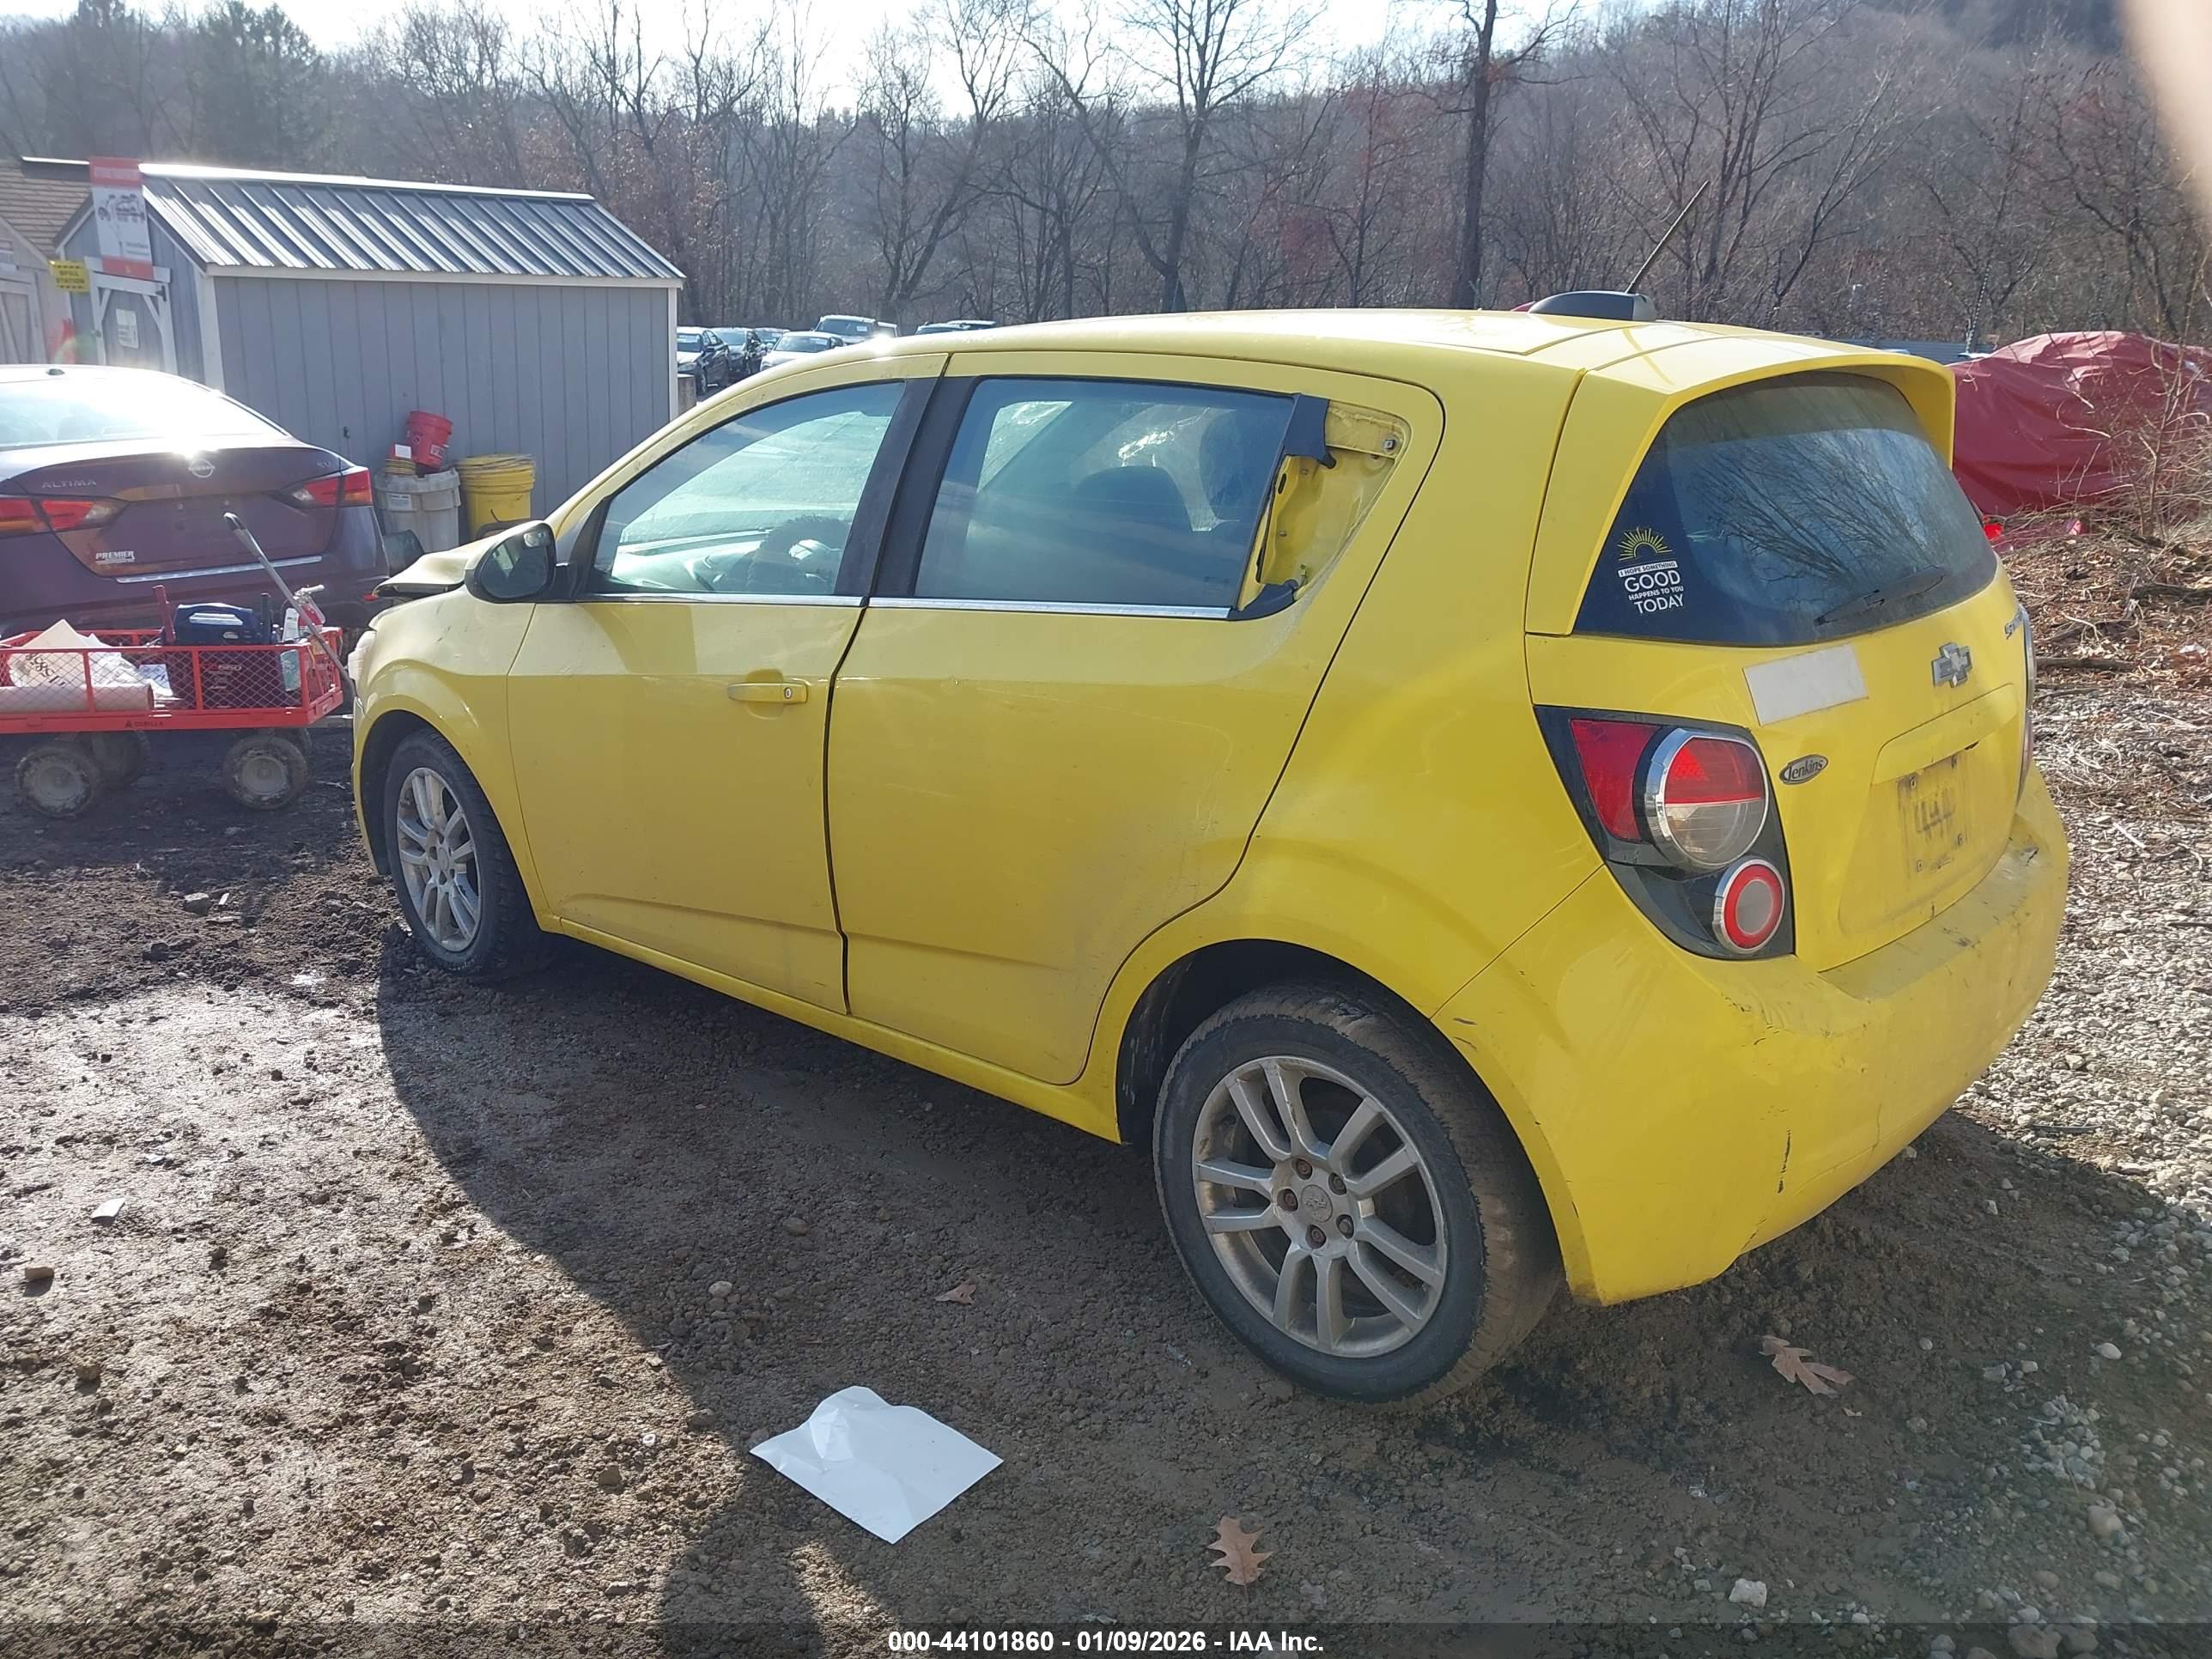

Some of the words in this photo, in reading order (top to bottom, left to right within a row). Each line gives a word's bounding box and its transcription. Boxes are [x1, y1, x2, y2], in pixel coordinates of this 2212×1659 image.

[41, 480, 97, 489] ALTIMA
[95, 550, 135, 560] PREMIER
[1642, 562, 1676, 572] SOMETHING
[1624, 570, 1680, 592] GOOD
[1628, 589, 1660, 601] HAPPENS
[1633, 593, 1684, 614] TODAY
[1783, 759, 1824, 782] Jenkins
